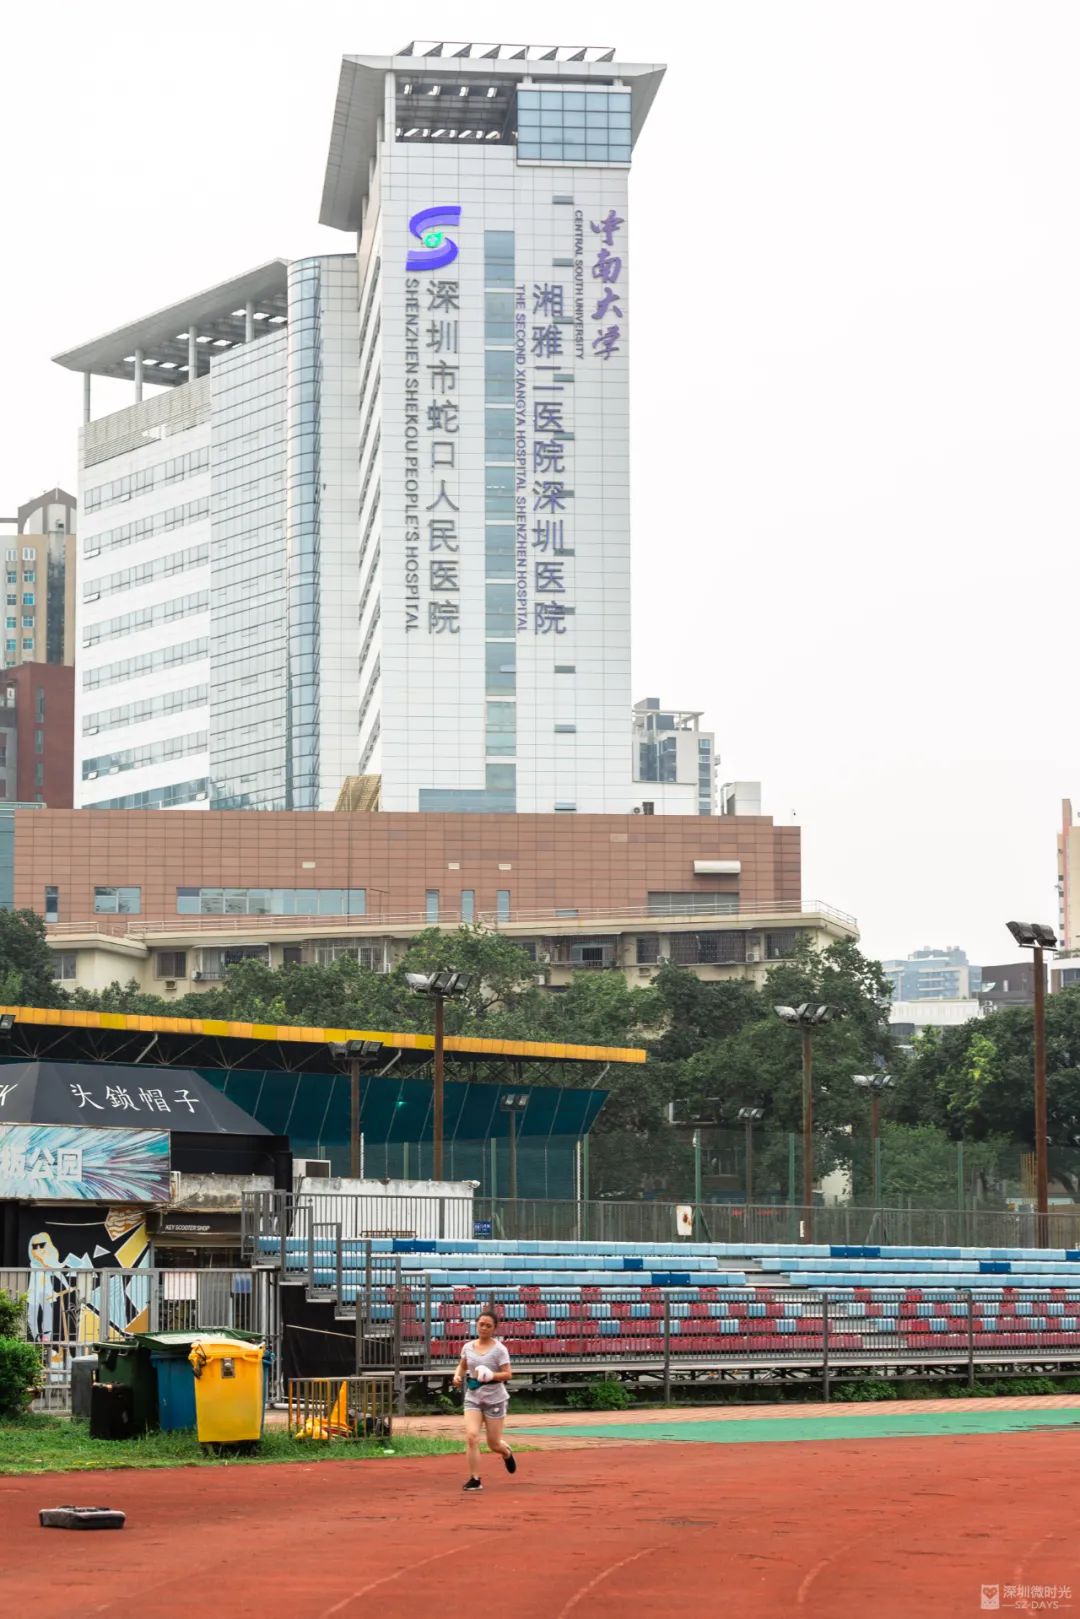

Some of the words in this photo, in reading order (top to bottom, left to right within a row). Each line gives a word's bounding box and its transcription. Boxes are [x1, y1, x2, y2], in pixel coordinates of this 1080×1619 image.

[575, 209, 583, 256] CENTRAL
[515, 284, 526, 309] THE
[575, 260, 583, 297] SOUTH
[405, 278, 419, 374] SHENZHEN
[515, 313, 526, 365] SECOND
[575, 299, 584, 360] UNIVERSITY
[405, 378, 419, 452] SHEKOU
[515, 369, 526, 426] XIANGYA
[425, 279, 460, 635] 深圳市蛇口人民医院
[516, 430, 527, 491] HOSPITAL
[531, 283, 566, 635] 湘雅二医院深圳医院
[405, 456, 419, 541] PEOPLE'S
[516, 496, 528, 567] SHENZHEN
[405, 546, 419, 634] HOSPITAL
[516, 570, 528, 634] HOSPITAL
